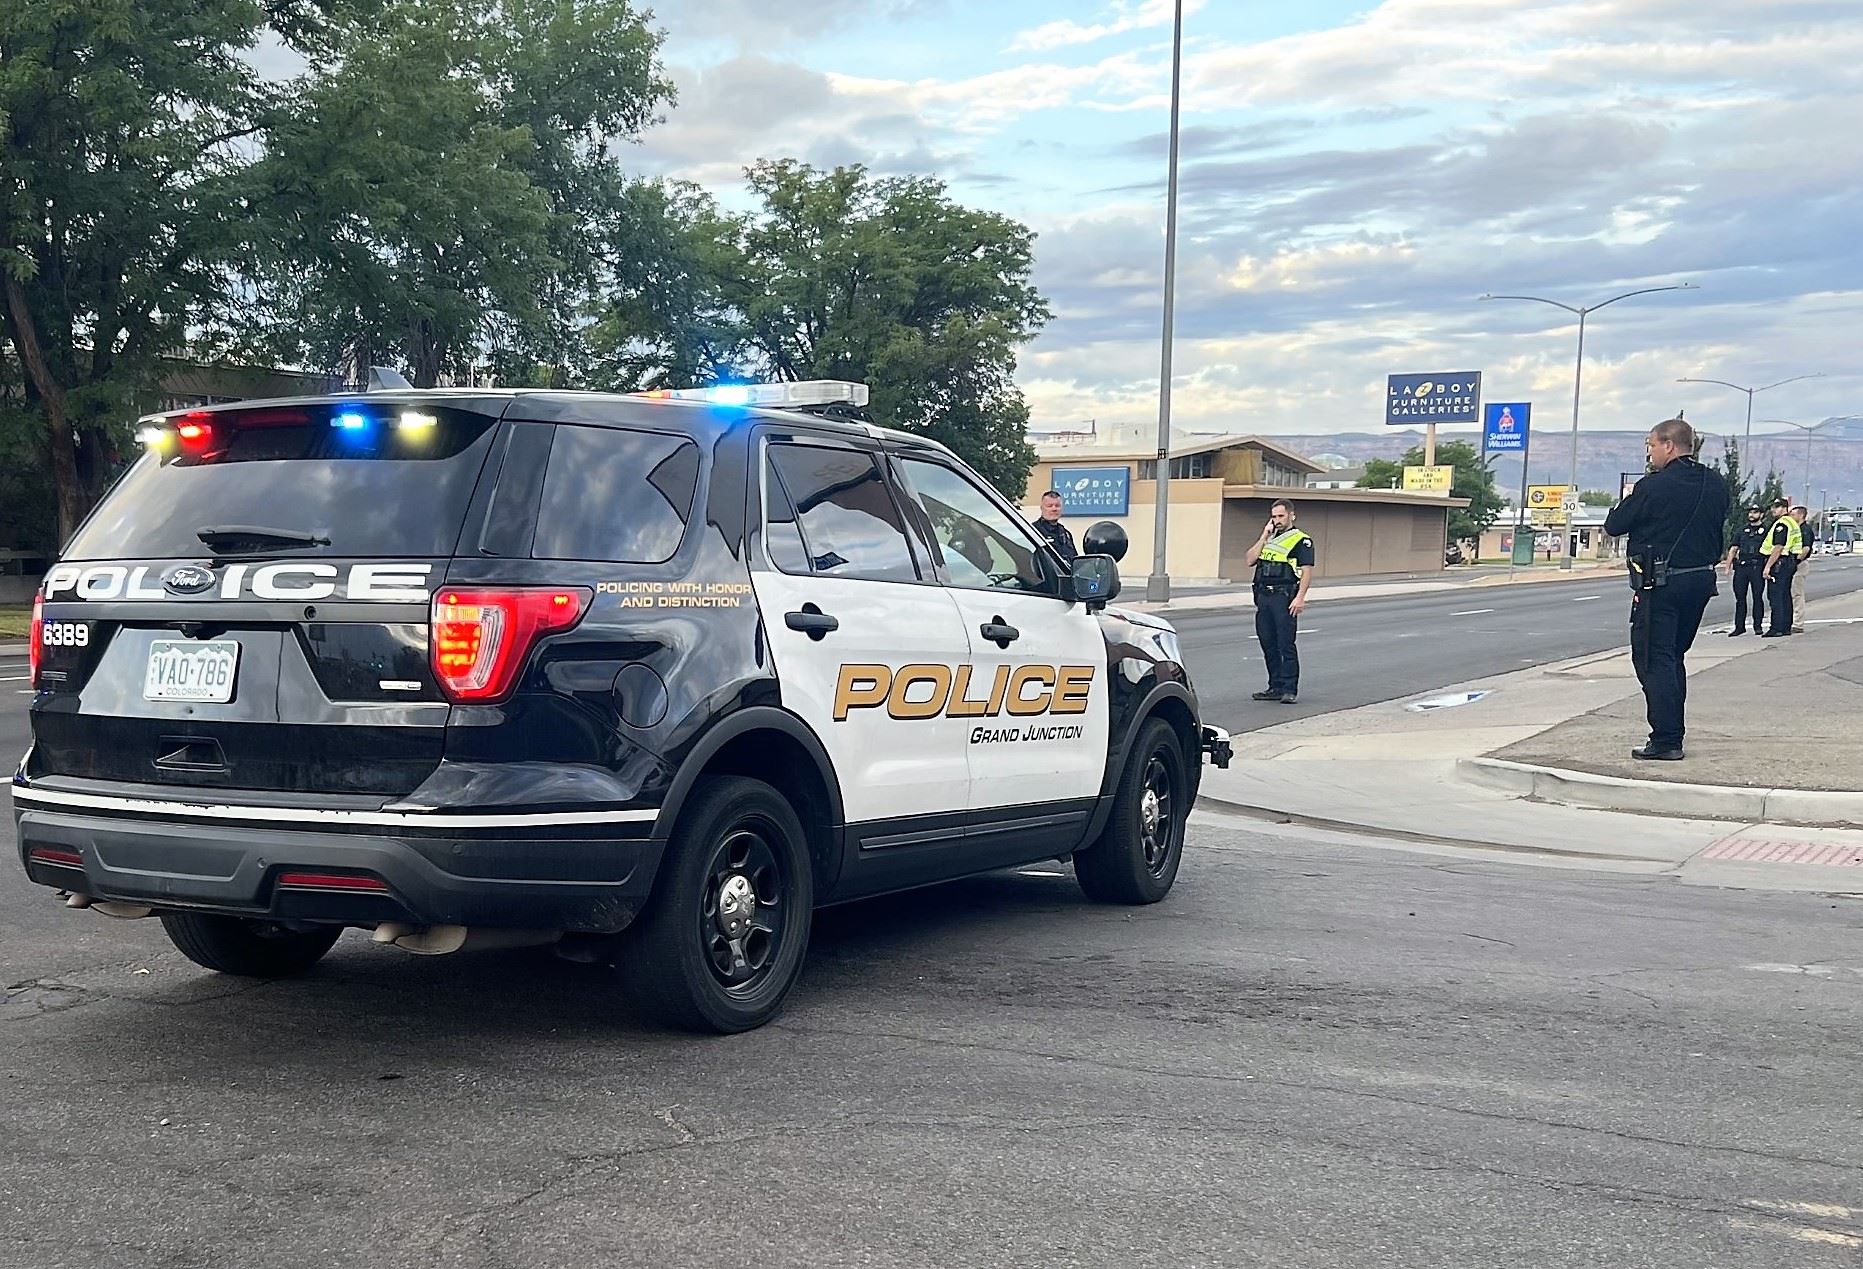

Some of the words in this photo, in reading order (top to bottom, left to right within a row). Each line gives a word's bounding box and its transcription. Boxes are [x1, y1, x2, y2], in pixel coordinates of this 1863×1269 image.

[1392, 396, 1471, 407] FURNITURE
[1392, 405, 1470, 415] GALLERIES
[1488, 432, 1521, 440] SHERWIN
[1562, 502, 1576, 511] 30
[171, 569, 201, 587] Ford
[596, 582, 663, 594] POLICING
[667, 582, 702, 594] WITH
[705, 583, 753, 594] HONOR
[620, 596, 654, 608] AND
[658, 596, 740, 608] DISTINCTION
[43, 623, 89, 647] 6389
[165, 687, 208, 697] COLORADO
[832, 663, 1095, 722] POLICE
[970, 726, 1019, 745] GRAND
[1022, 724, 1084, 744] JUNCTION
